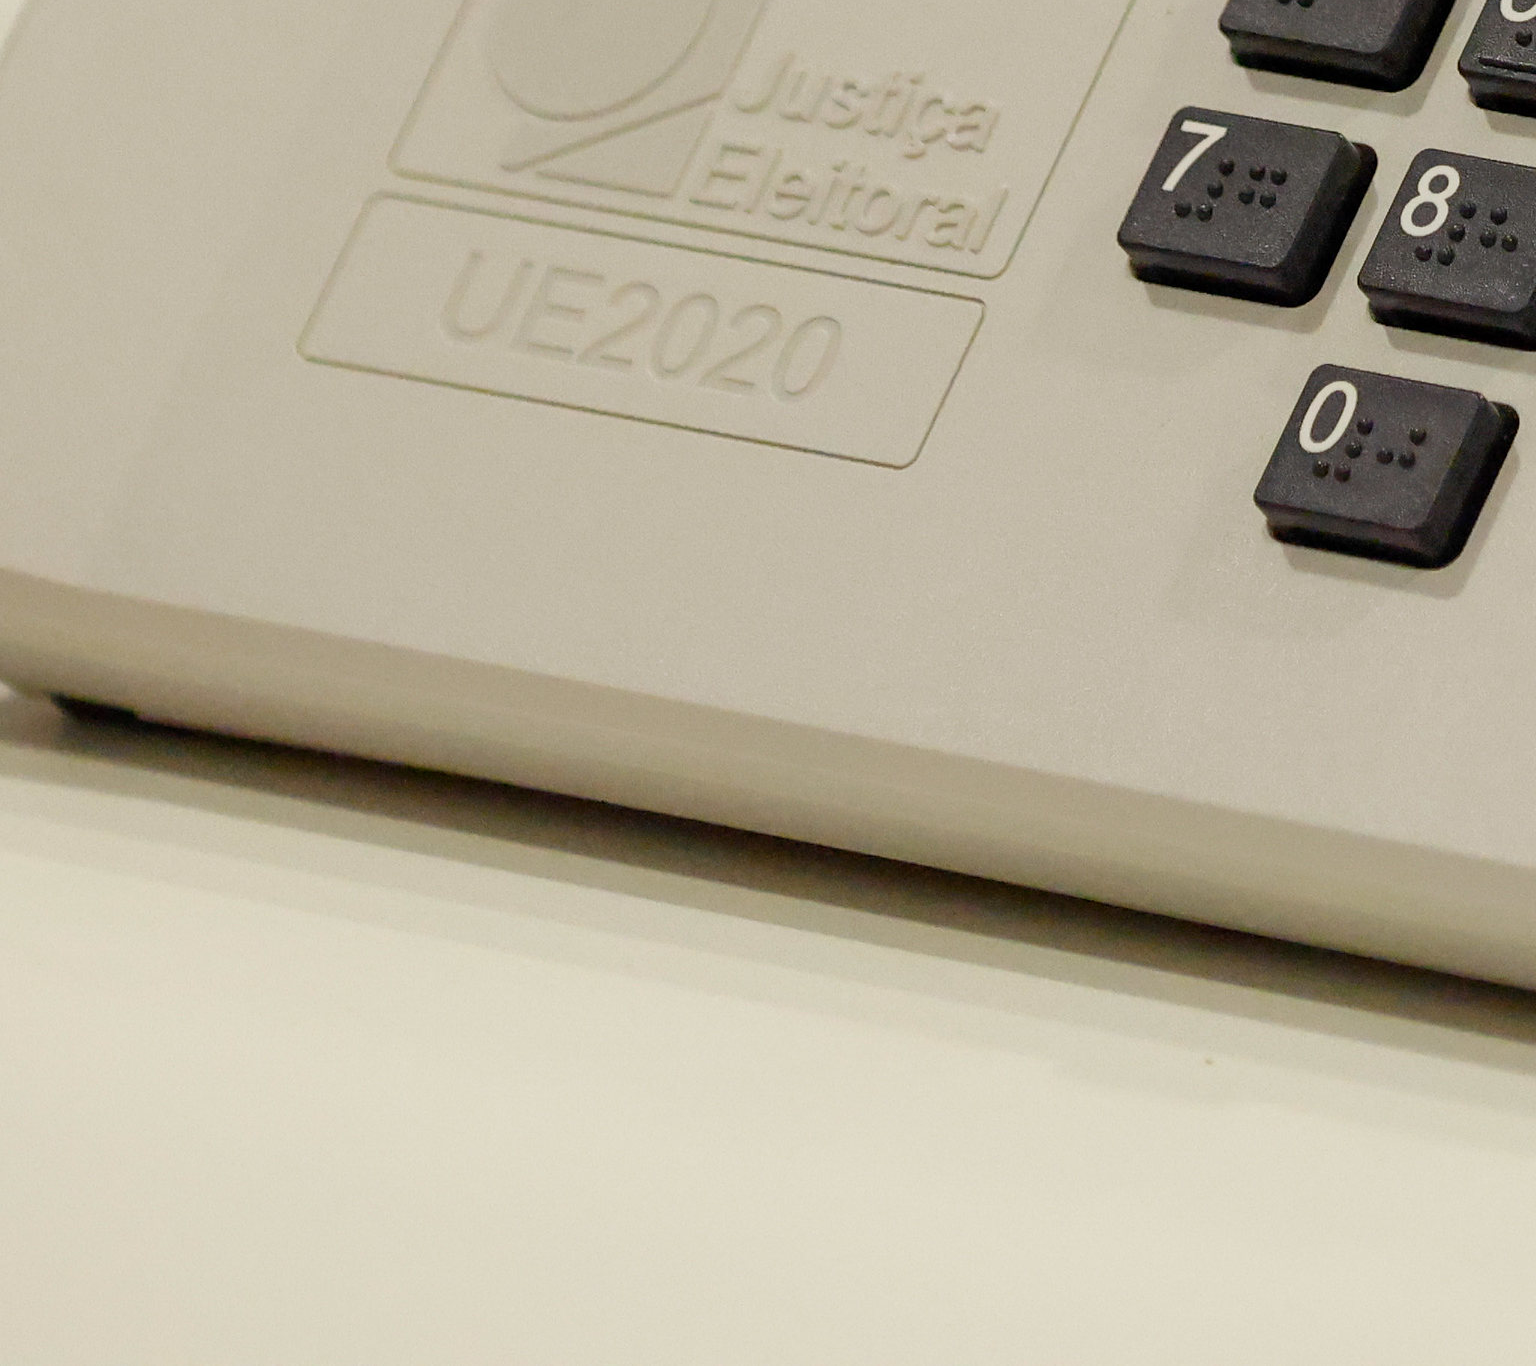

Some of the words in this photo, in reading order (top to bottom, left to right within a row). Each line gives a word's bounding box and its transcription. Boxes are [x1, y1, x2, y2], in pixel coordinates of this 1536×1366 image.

[732, 54, 1001, 159] Justiça
[687, 140, 1011, 257] Eleitoral
[1161, 120, 1228, 192] 7
[1399, 165, 1461, 237] 8
[440, 248, 844, 404] UE2020
[1299, 380, 1359, 454] 0
